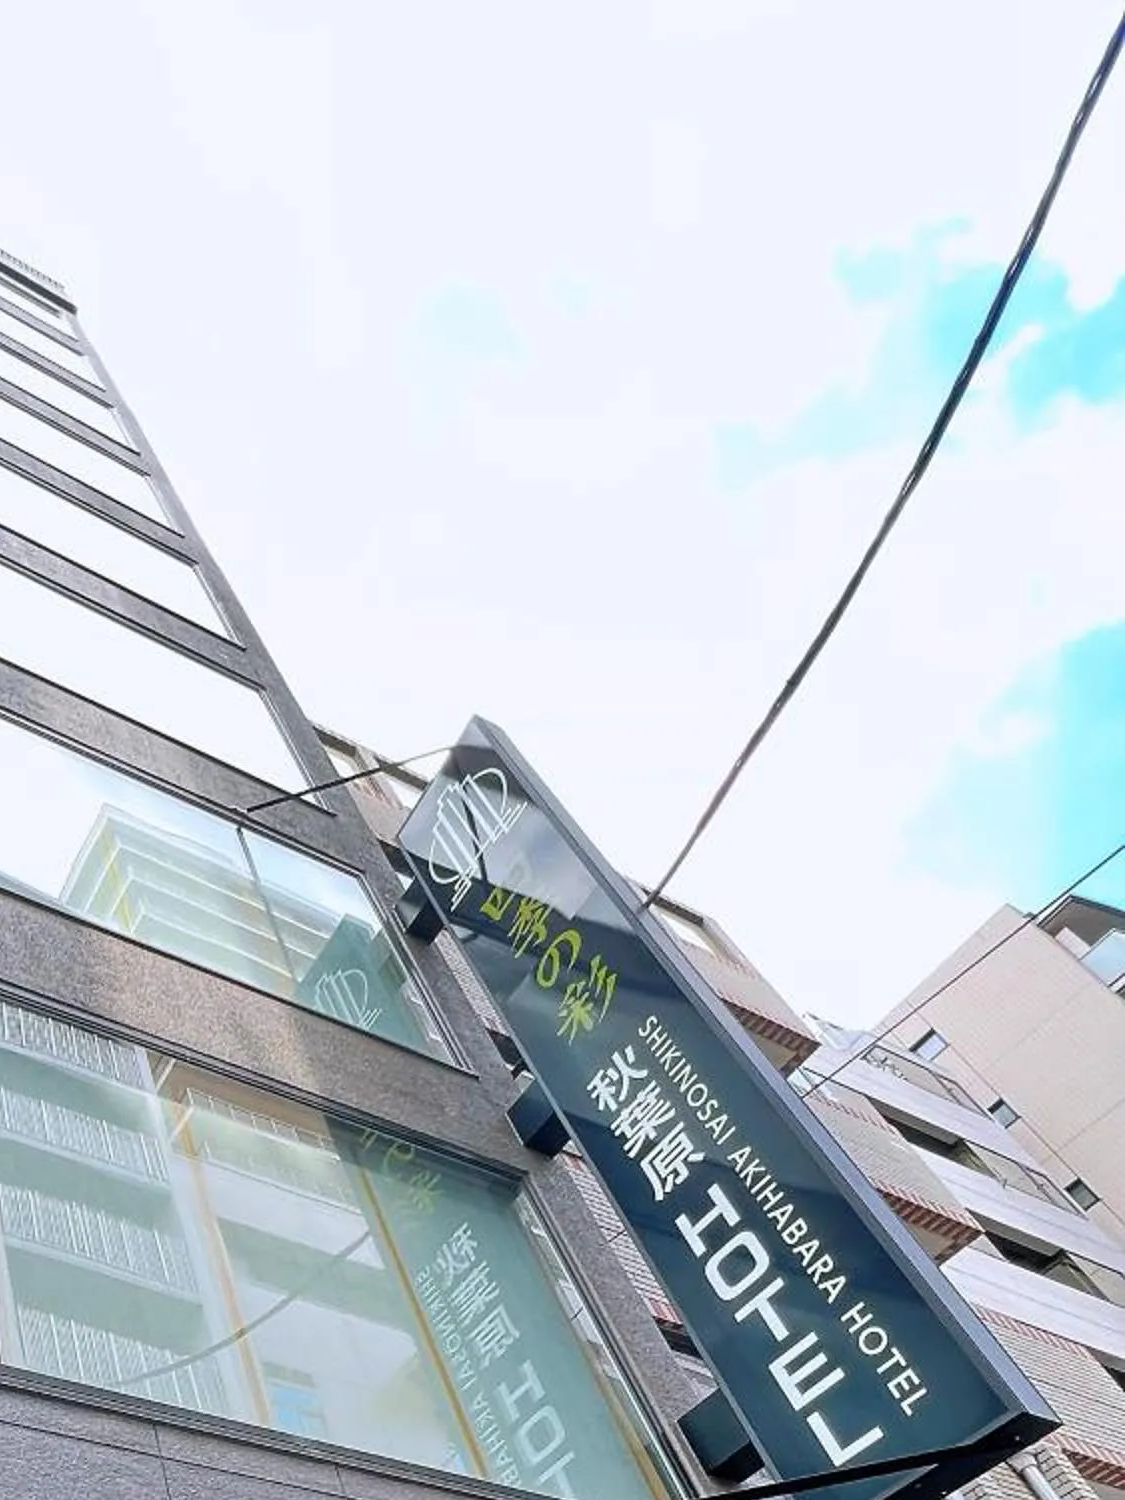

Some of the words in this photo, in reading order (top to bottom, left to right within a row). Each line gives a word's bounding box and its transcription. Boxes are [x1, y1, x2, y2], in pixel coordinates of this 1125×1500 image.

[586, 1043, 706, 1202] 秋葉原
[674, 1183, 885, 1467] HOTEL
[637, 1015, 732, 1148] SHIKINOSAI
[727, 1146, 847, 1304] AKIHABARA
[840, 1301, 930, 1417] HOTEL
